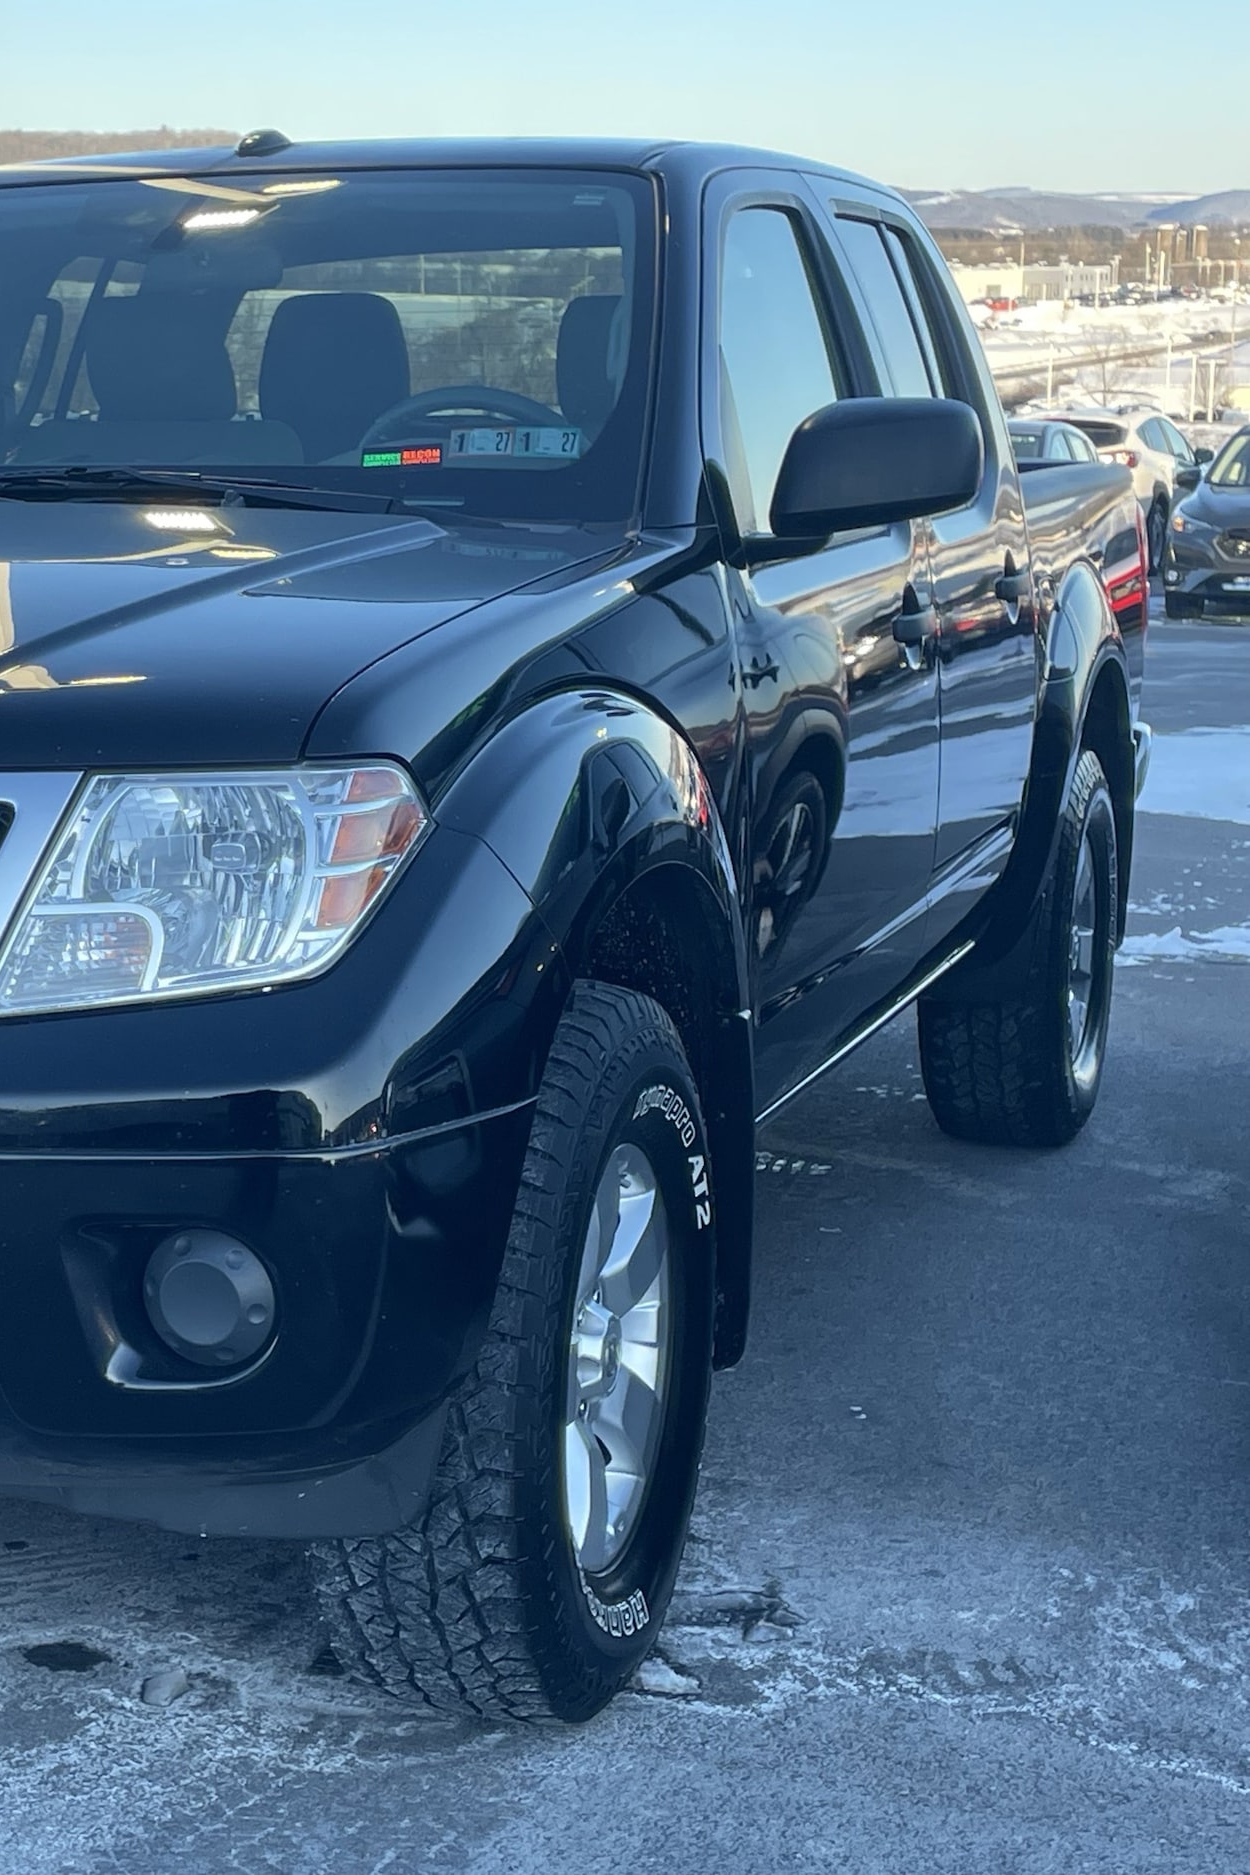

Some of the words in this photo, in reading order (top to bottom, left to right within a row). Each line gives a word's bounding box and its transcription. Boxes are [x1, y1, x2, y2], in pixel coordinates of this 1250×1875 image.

[495, 432, 511, 453] 27
[561, 432, 578, 453] 27
[688, 1154, 712, 1230] AT2
